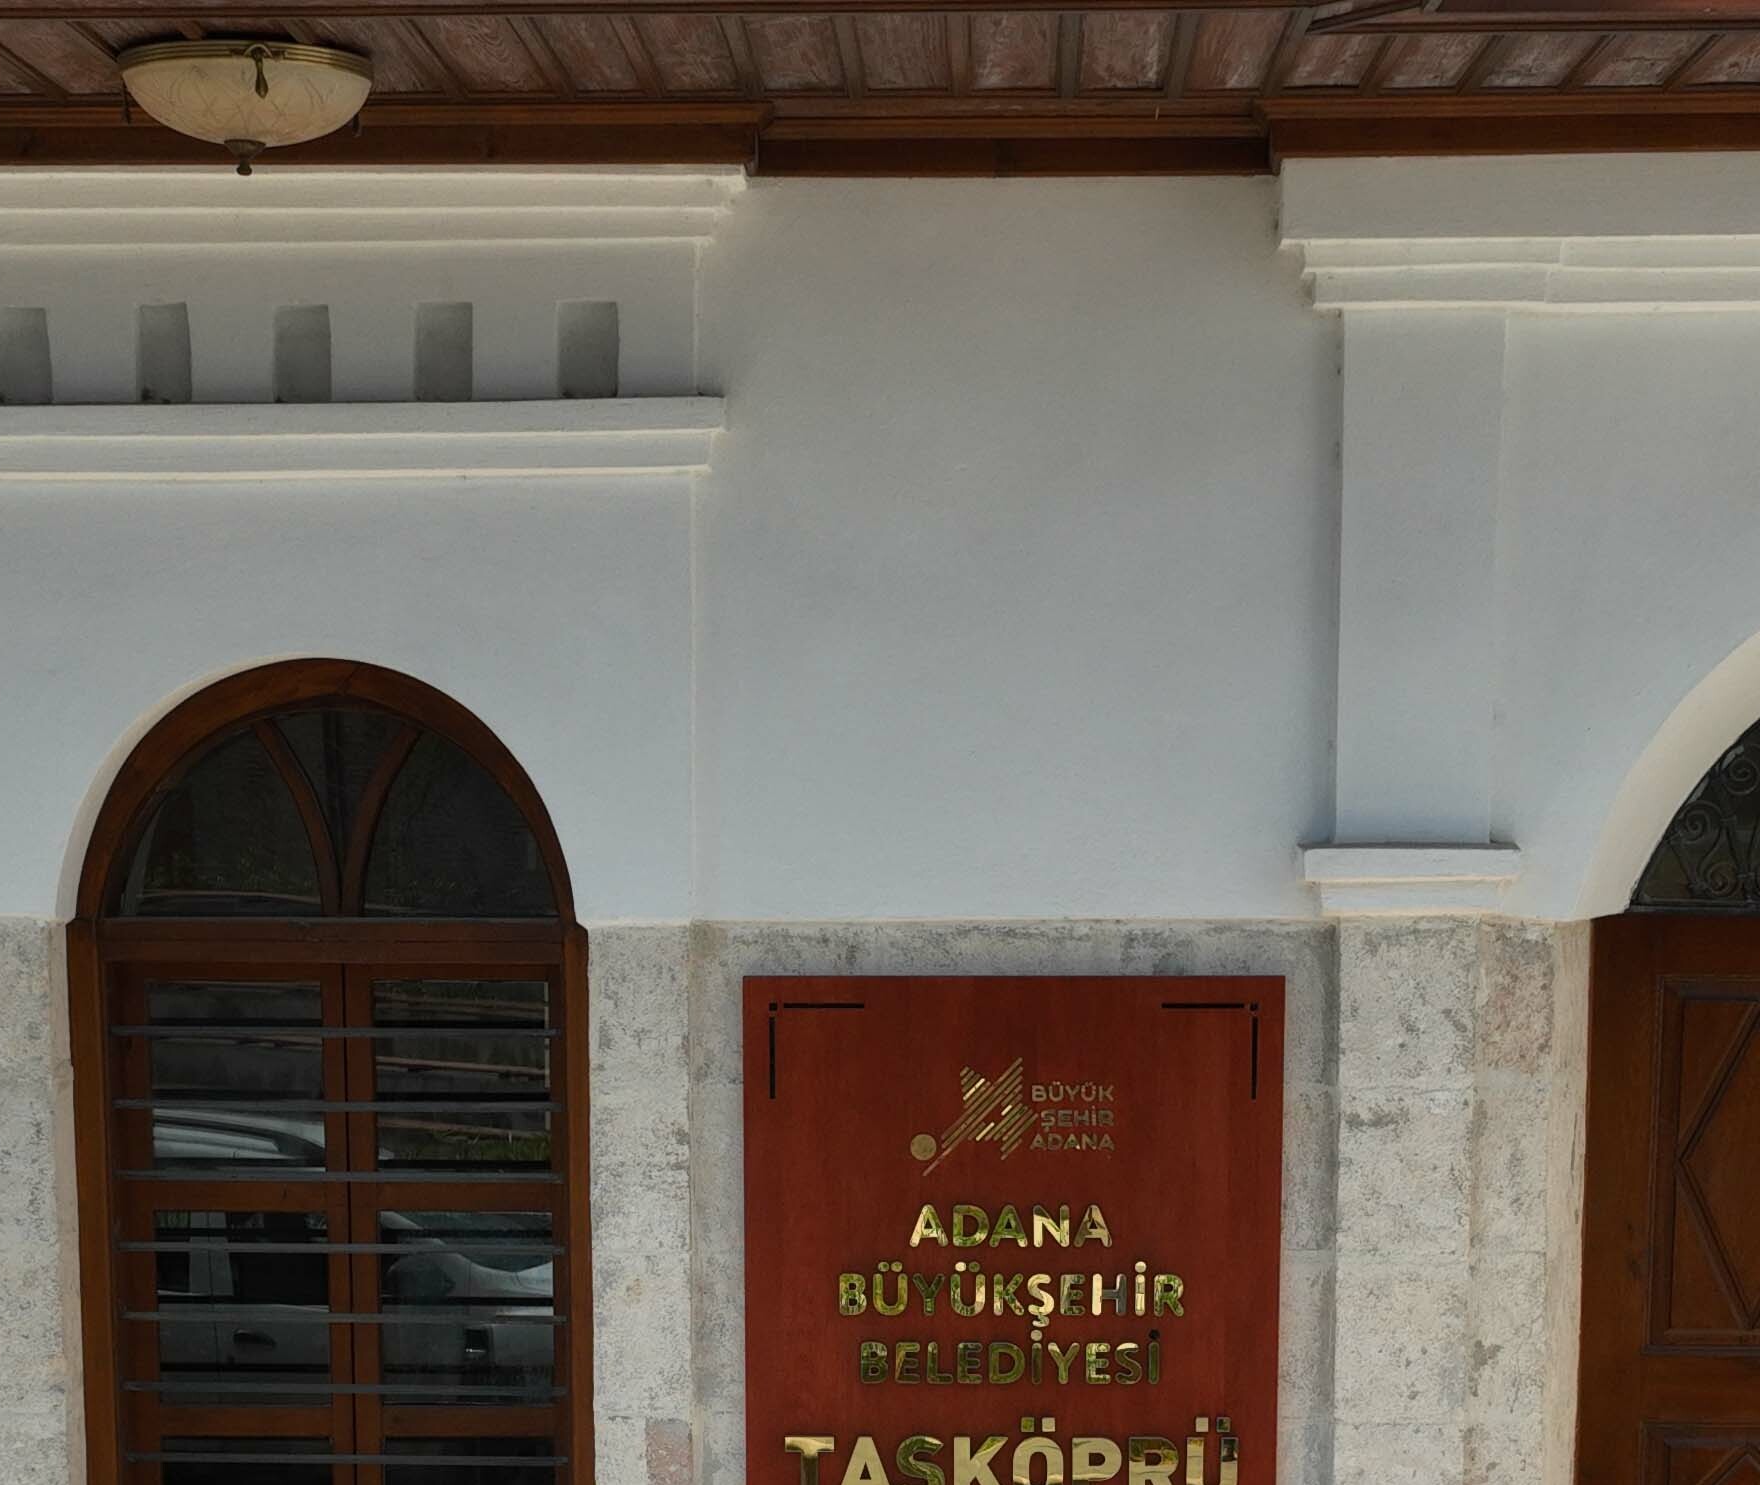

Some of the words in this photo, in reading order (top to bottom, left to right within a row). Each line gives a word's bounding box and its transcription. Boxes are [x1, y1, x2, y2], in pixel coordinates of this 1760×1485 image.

[1031, 1081, 1114, 1102] BÜYÜK
[1040, 1105, 1114, 1132] ŞEHİR
[1030, 1133, 1115, 1151] ADANA
[909, 1204, 1113, 1248] ADANA
[838, 1261, 1185, 1327] BÜYÜKŞEHİR
[859, 1328, 1162, 1384] BELEDİYESİ
